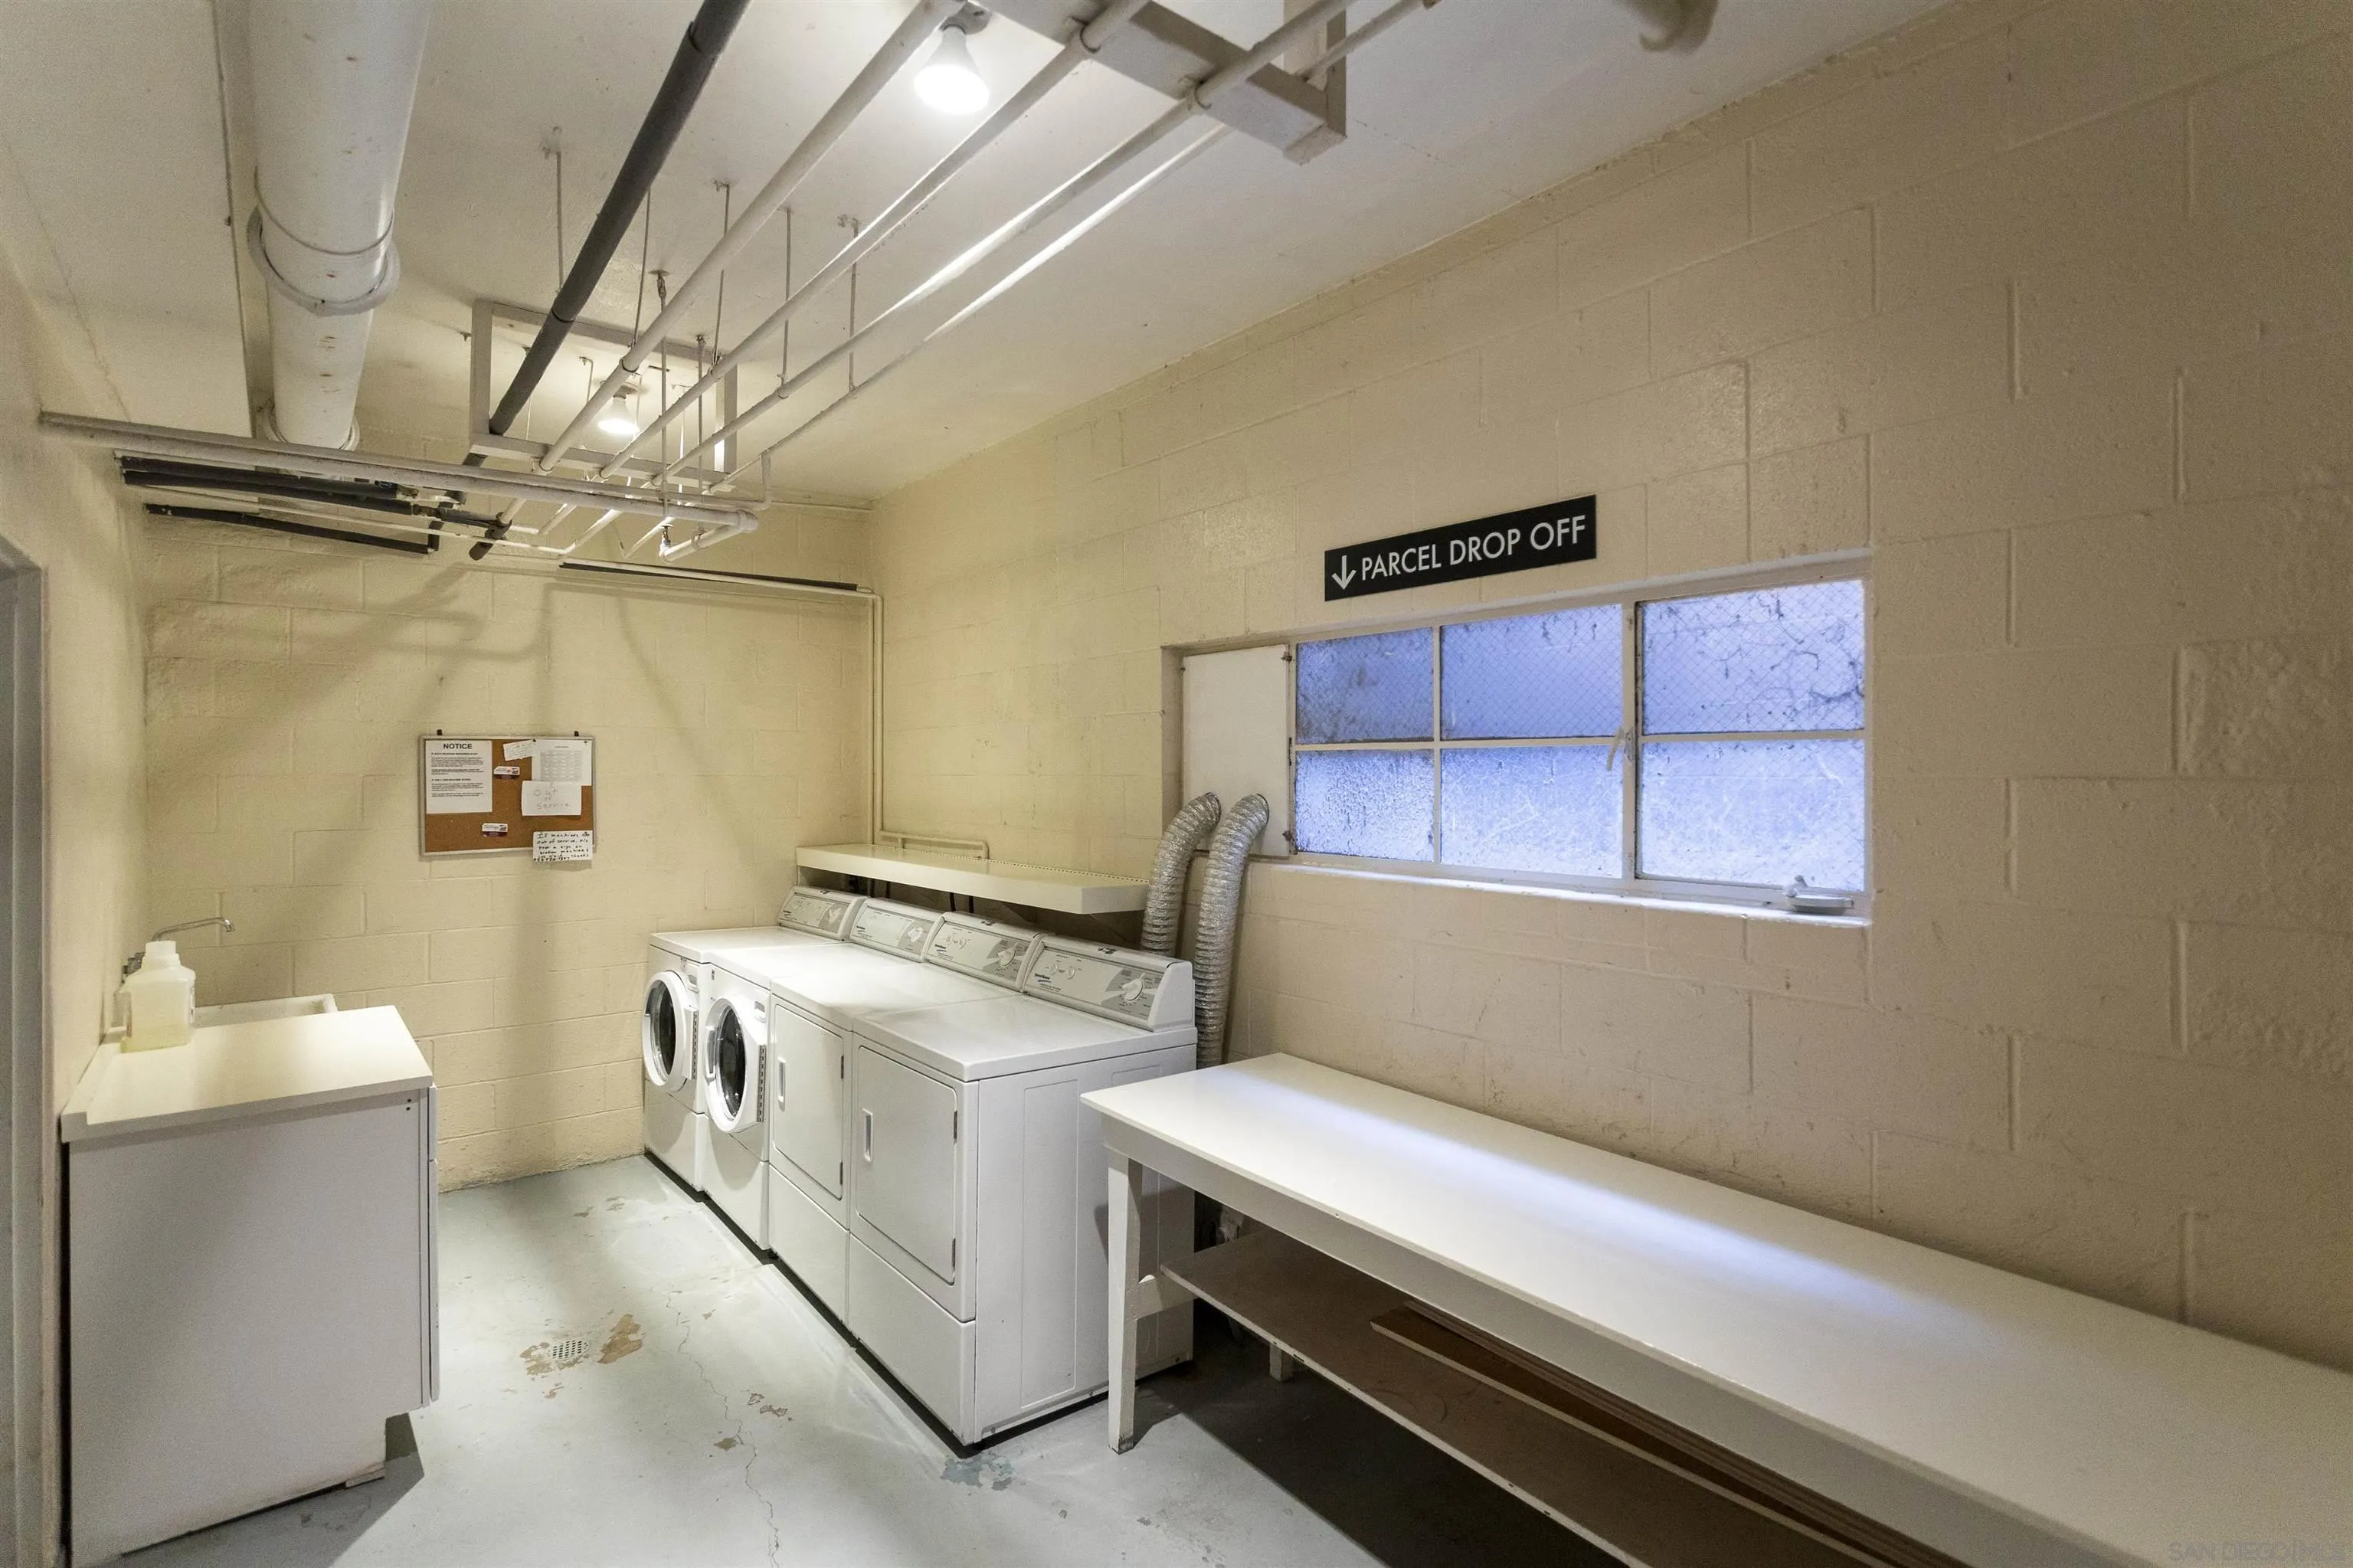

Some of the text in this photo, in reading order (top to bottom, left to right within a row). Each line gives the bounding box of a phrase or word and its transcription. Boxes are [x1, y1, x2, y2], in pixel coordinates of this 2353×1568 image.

[1361, 515, 1586, 581] PARCEL DROP OFF
